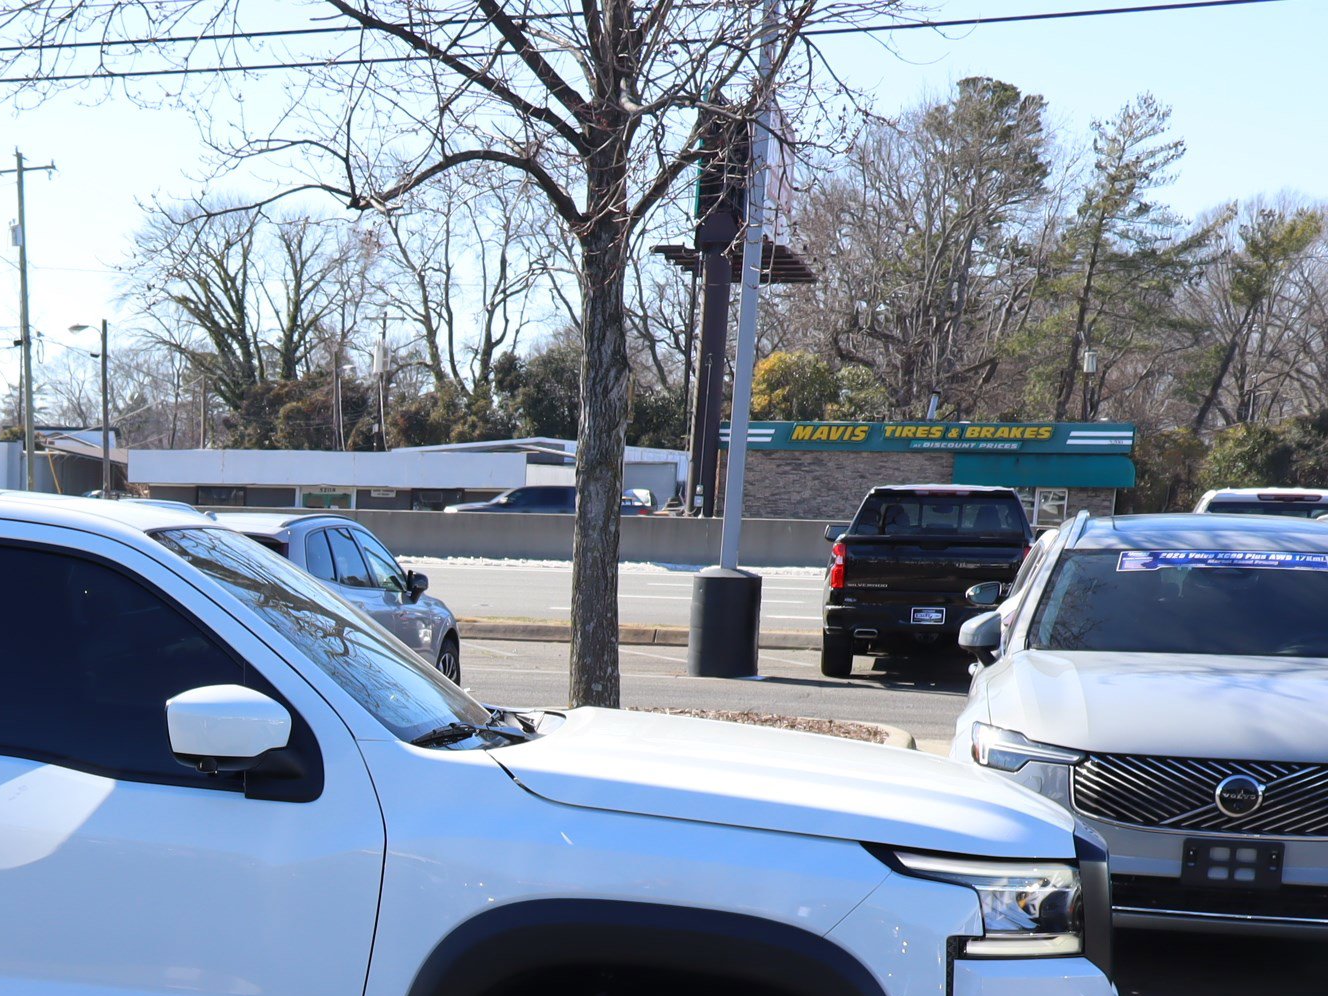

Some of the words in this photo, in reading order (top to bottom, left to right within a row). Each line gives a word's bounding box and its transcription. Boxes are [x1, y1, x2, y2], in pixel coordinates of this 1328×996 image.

[791, 424, 869, 441] MAVIS
[884, 426, 943, 439] TIRES
[948, 427, 959, 439] &
[965, 426, 1053, 439] BRAKES
